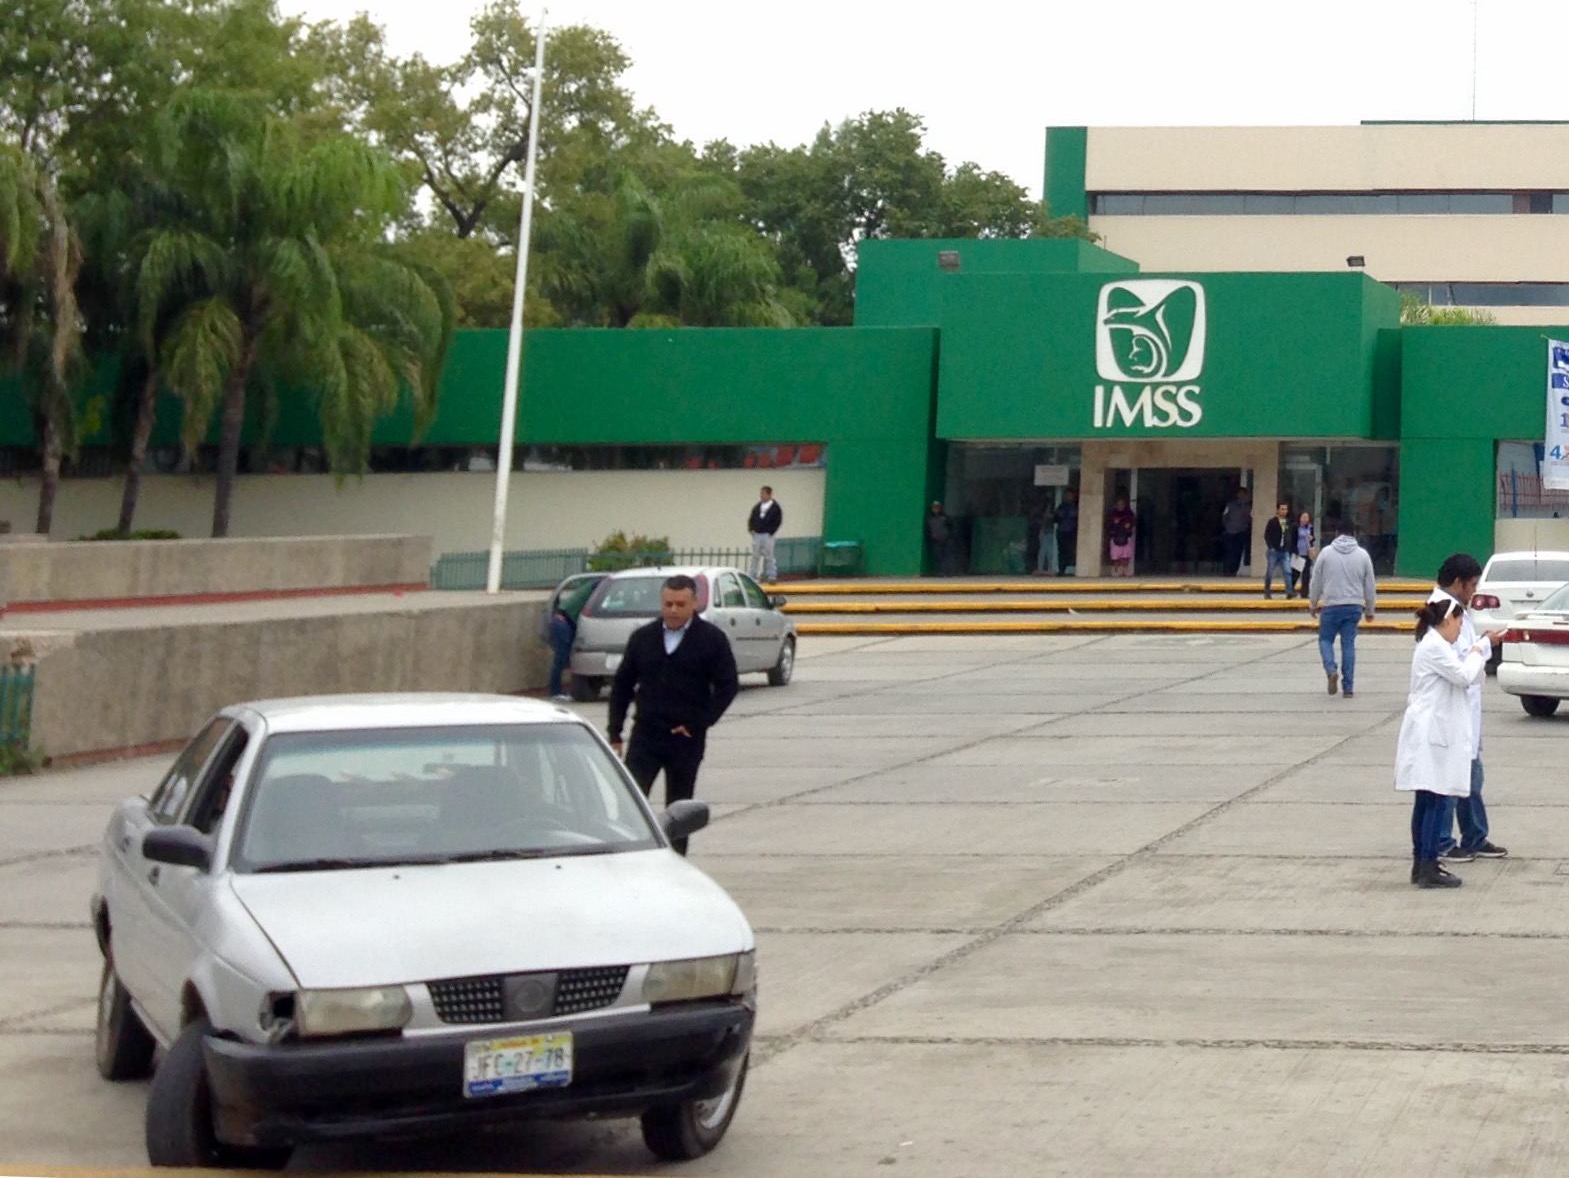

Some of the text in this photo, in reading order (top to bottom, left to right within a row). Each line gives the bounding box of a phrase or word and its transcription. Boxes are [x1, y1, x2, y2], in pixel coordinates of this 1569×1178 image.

[1093, 384, 1203, 429] IMSS
[1560, 413, 1568, 428] 1
[1549, 444, 1561, 460] 4
